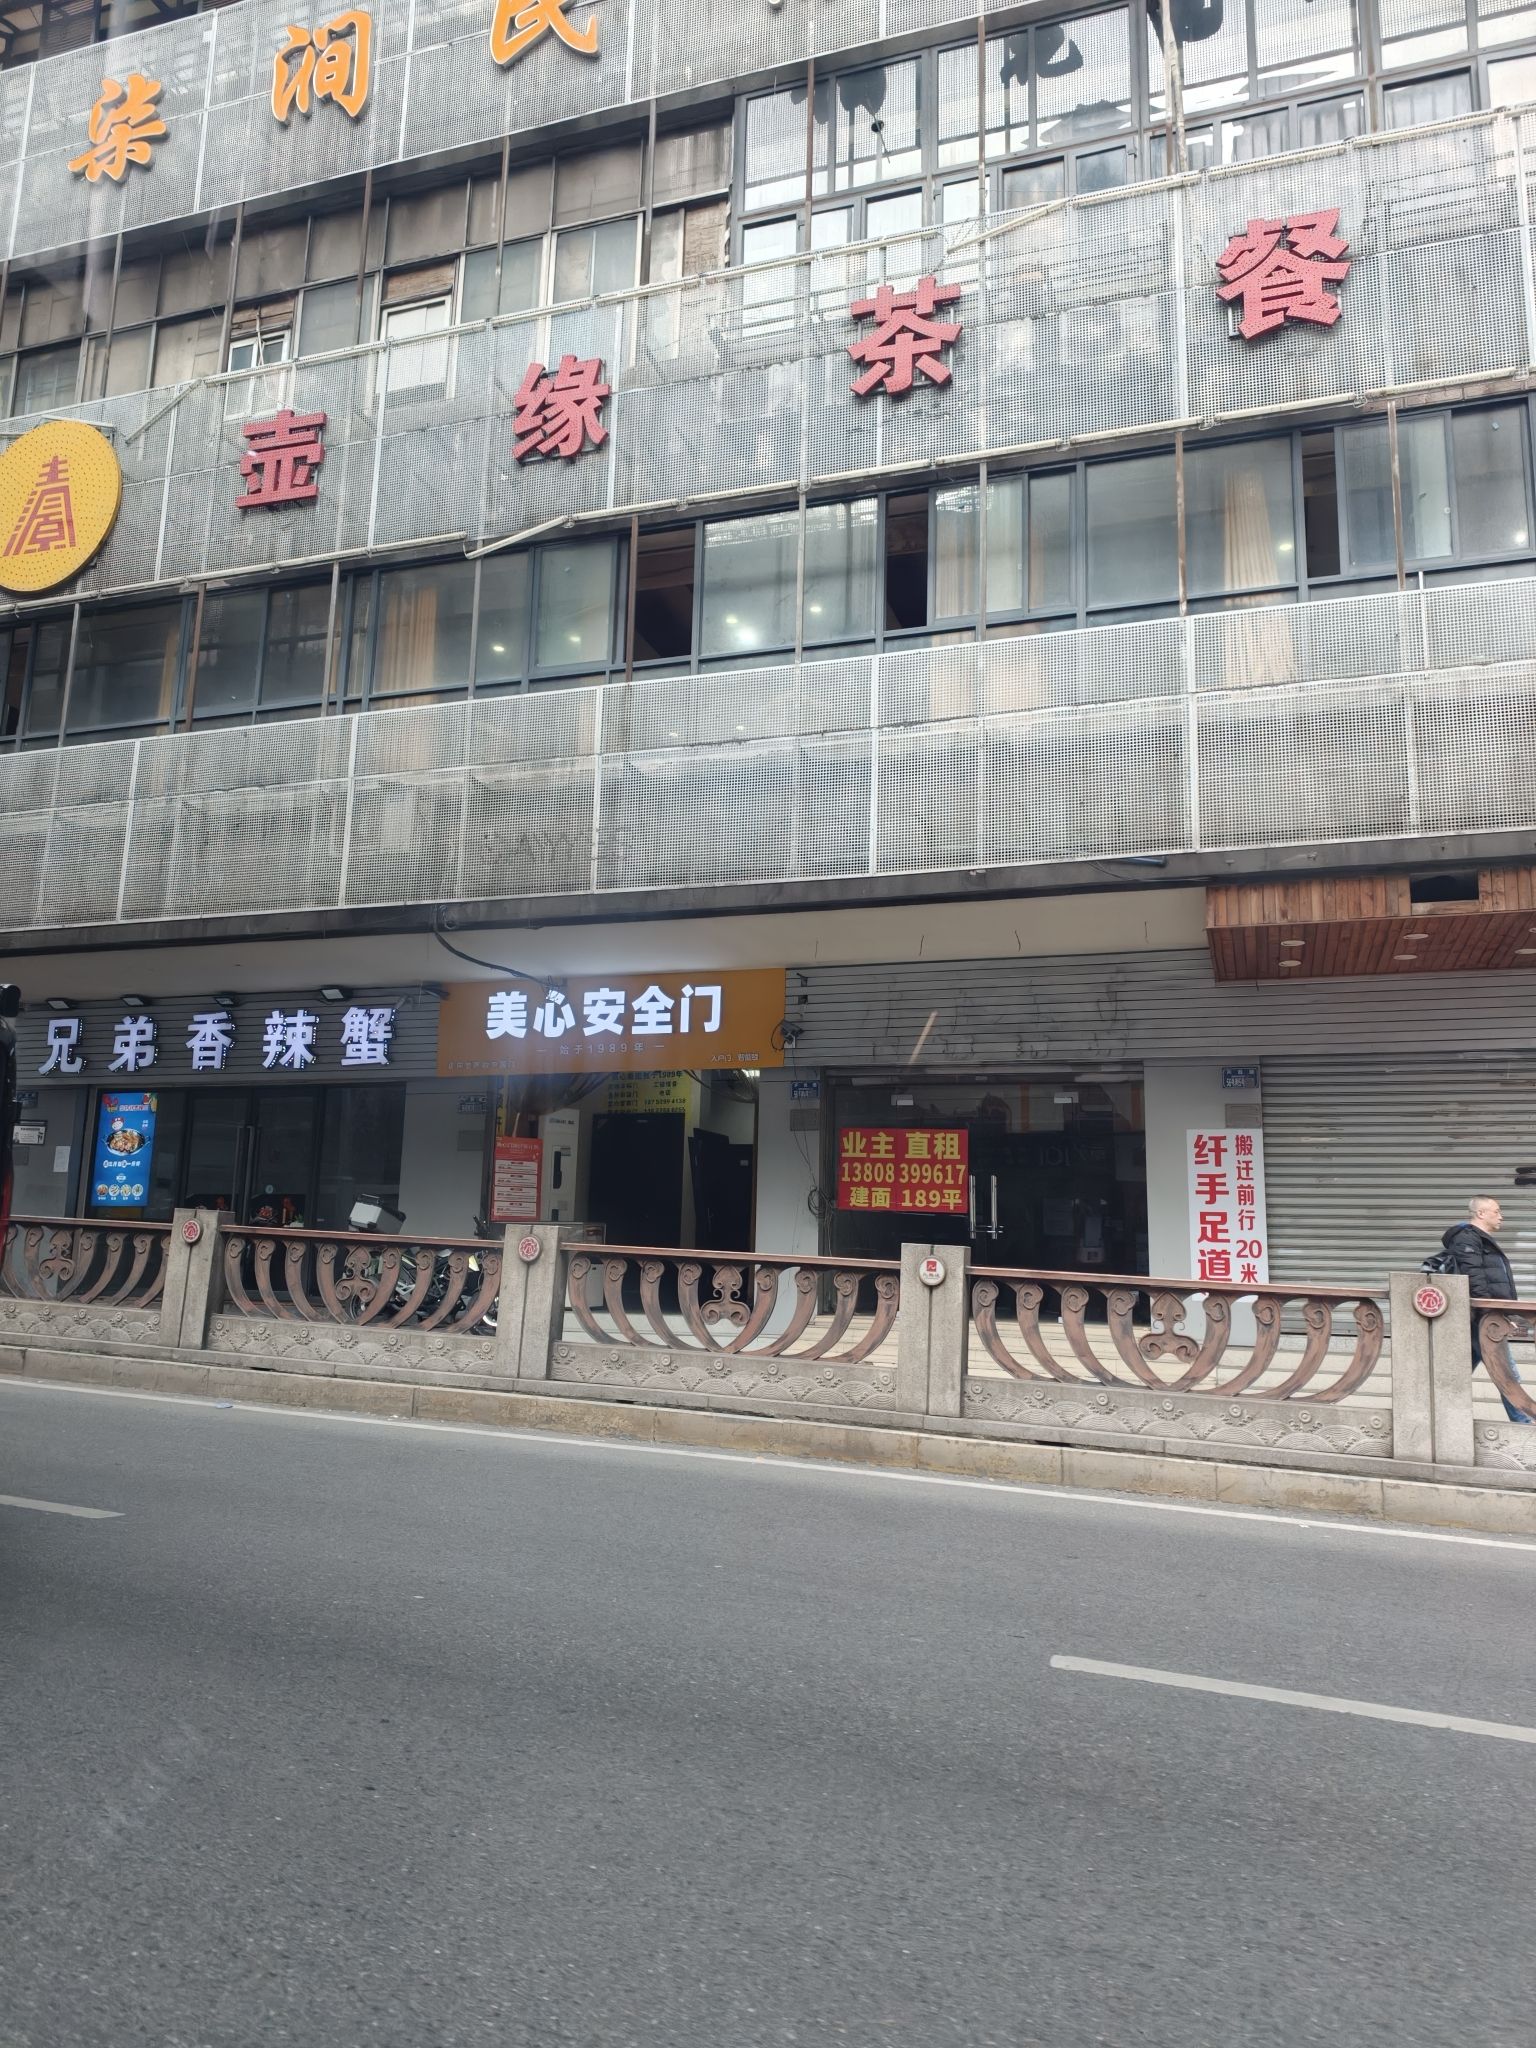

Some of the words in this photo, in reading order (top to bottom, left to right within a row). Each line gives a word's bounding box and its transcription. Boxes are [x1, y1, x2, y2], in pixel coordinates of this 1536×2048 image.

[485, 983, 723, 1040] 美心安全门
[37, 1006, 400, 1075] 兄弟香辣蟹
[841, 1132, 895, 1159] 业主
[904, 1132, 961, 1160] 直租
[841, 1162, 895, 1183] 13808
[899, 1164, 966, 1185] 399617
[849, 1186, 891, 1209] 建面
[901, 1189, 963, 1211] 189平
[1193, 1134, 1232, 1283] 纤手足道
[1234, 1134, 1263, 1284] 搬迁前行20米
